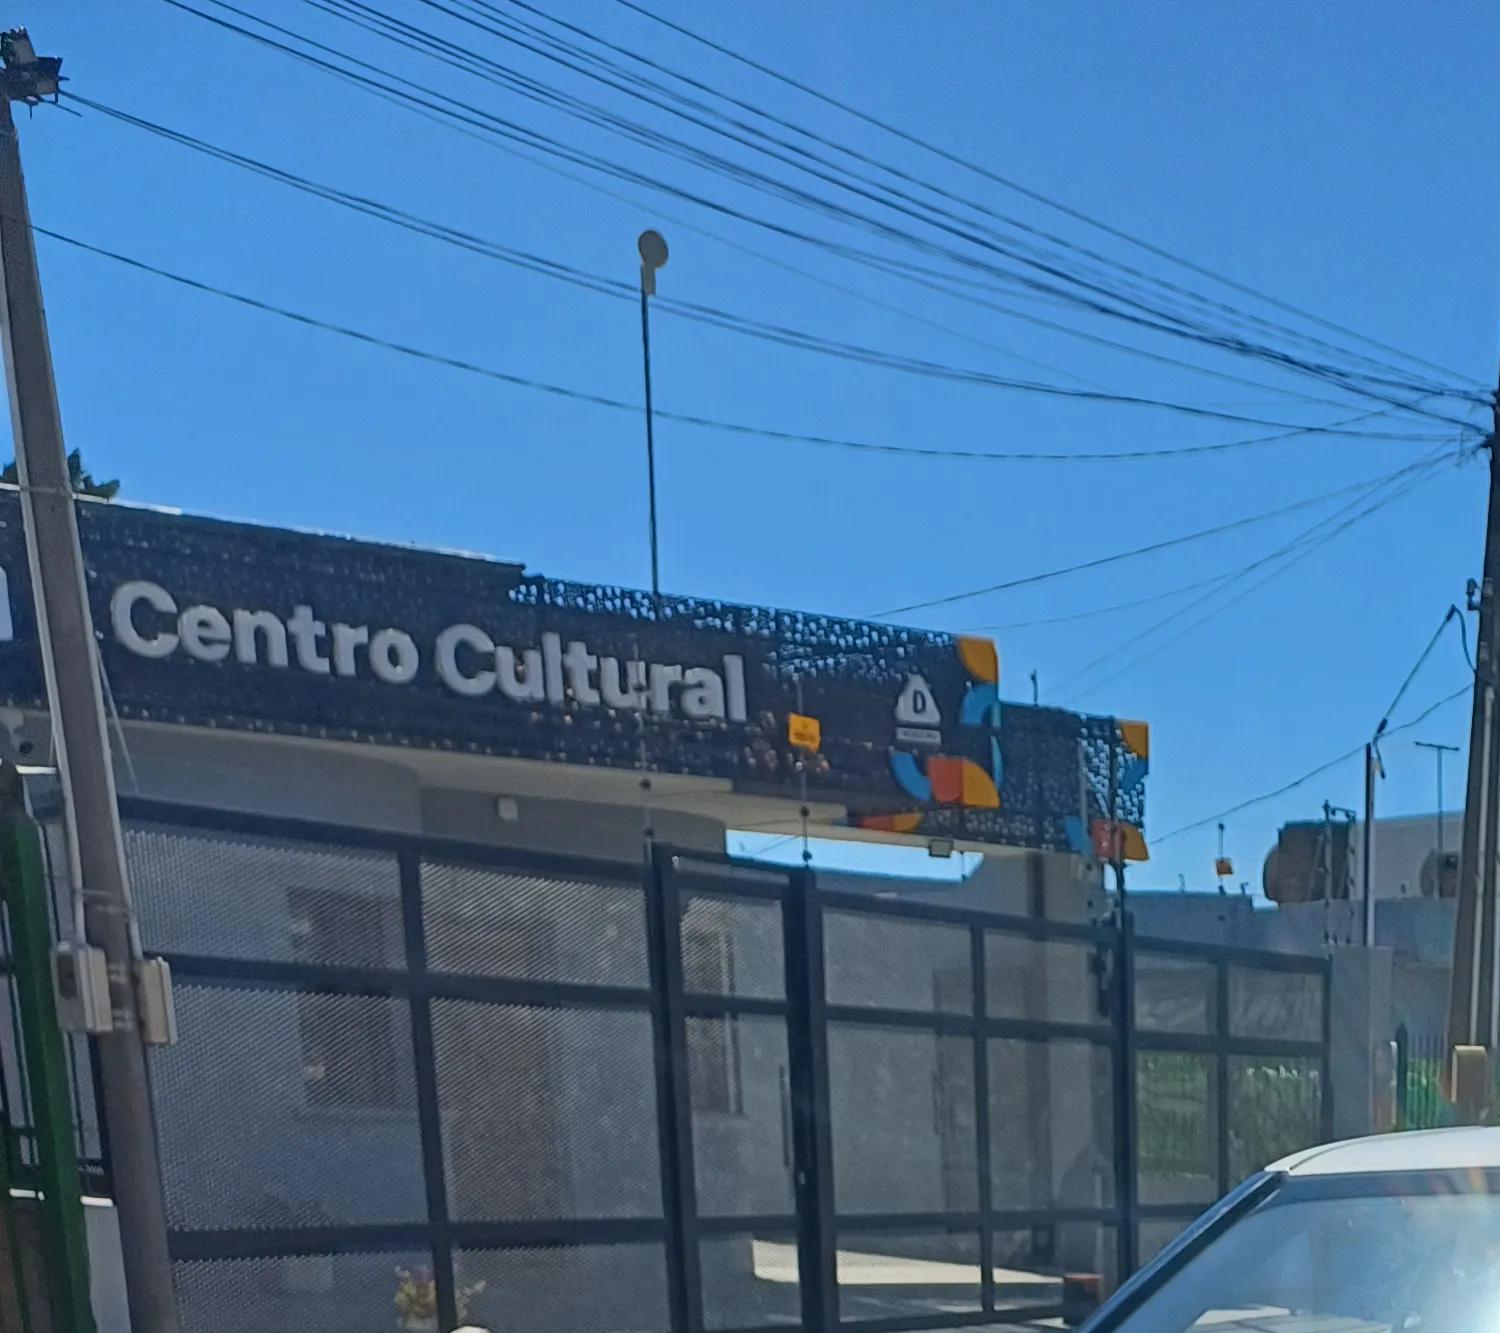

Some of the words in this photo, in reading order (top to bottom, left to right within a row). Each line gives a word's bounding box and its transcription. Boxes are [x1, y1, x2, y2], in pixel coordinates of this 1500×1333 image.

[110, 580, 420, 684] Centro
[434, 623, 747, 723] Cultural
[912, 689, 926, 714] D
